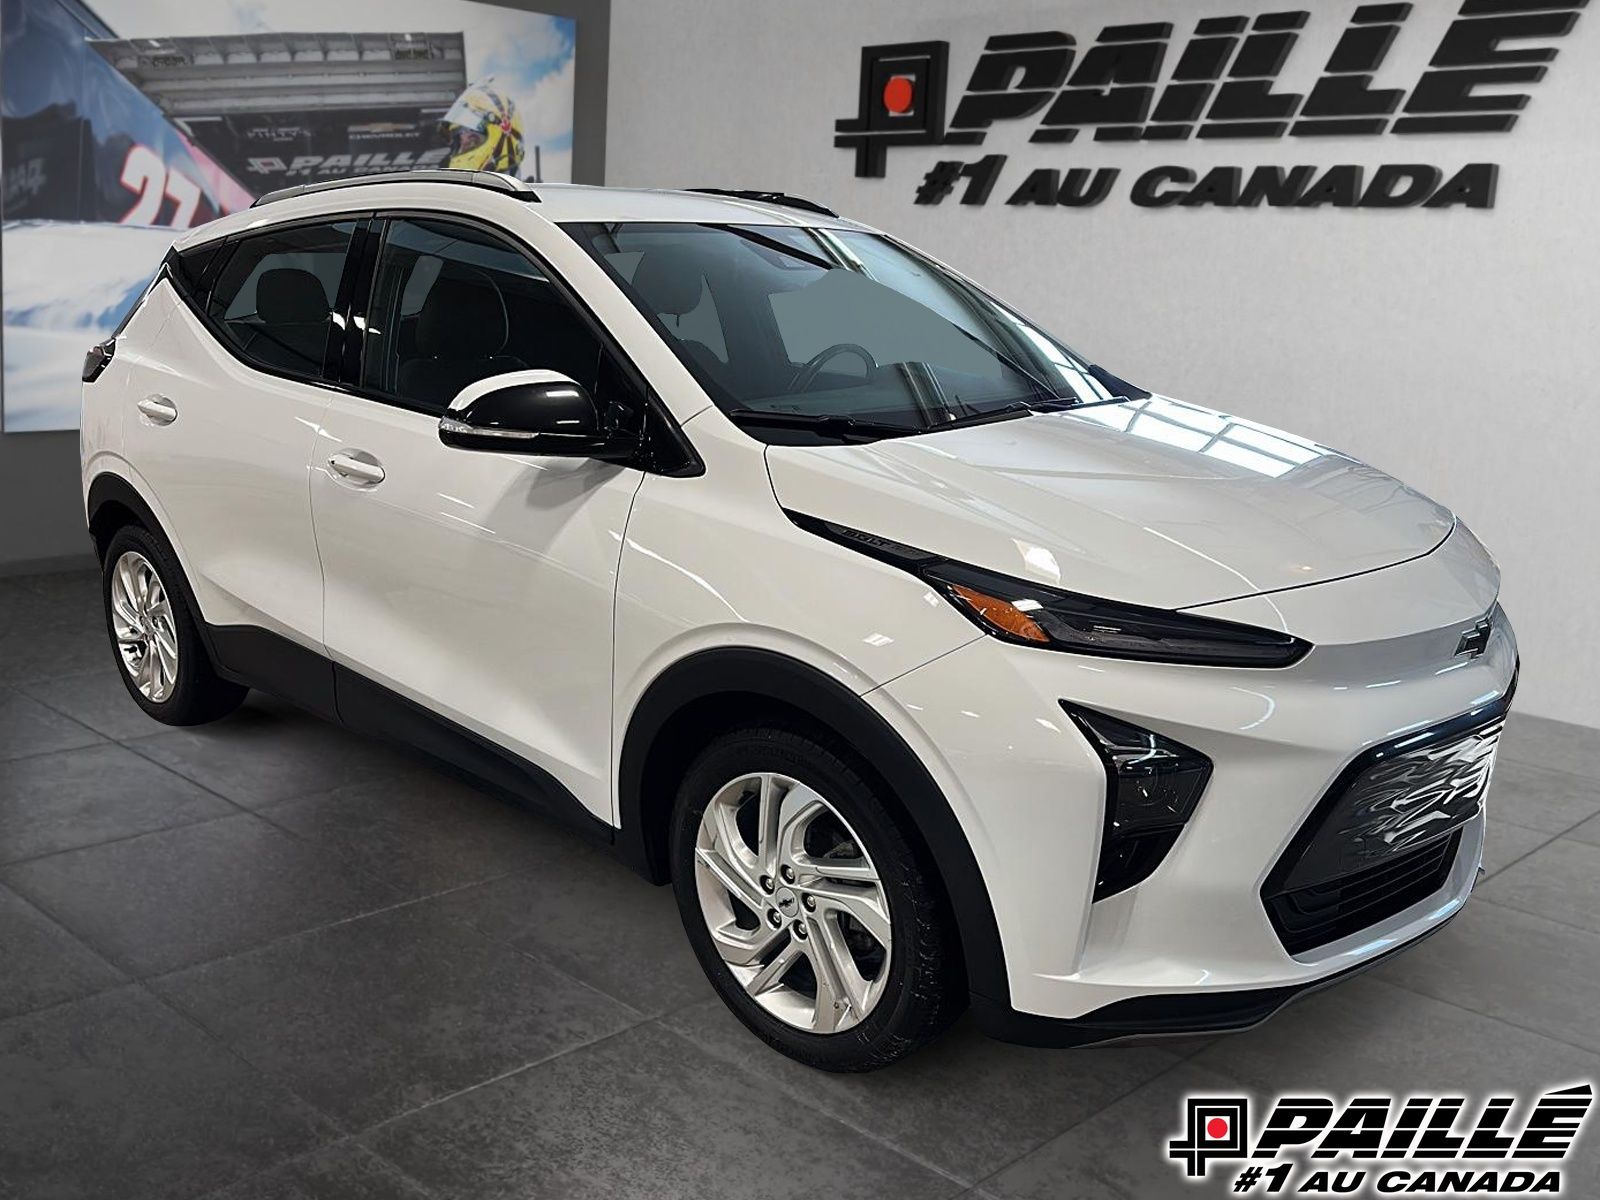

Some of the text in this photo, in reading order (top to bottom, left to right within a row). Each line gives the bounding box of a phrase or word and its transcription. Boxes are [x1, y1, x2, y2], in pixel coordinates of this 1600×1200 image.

[913, 154, 1499, 208] #1 AU CANADA
